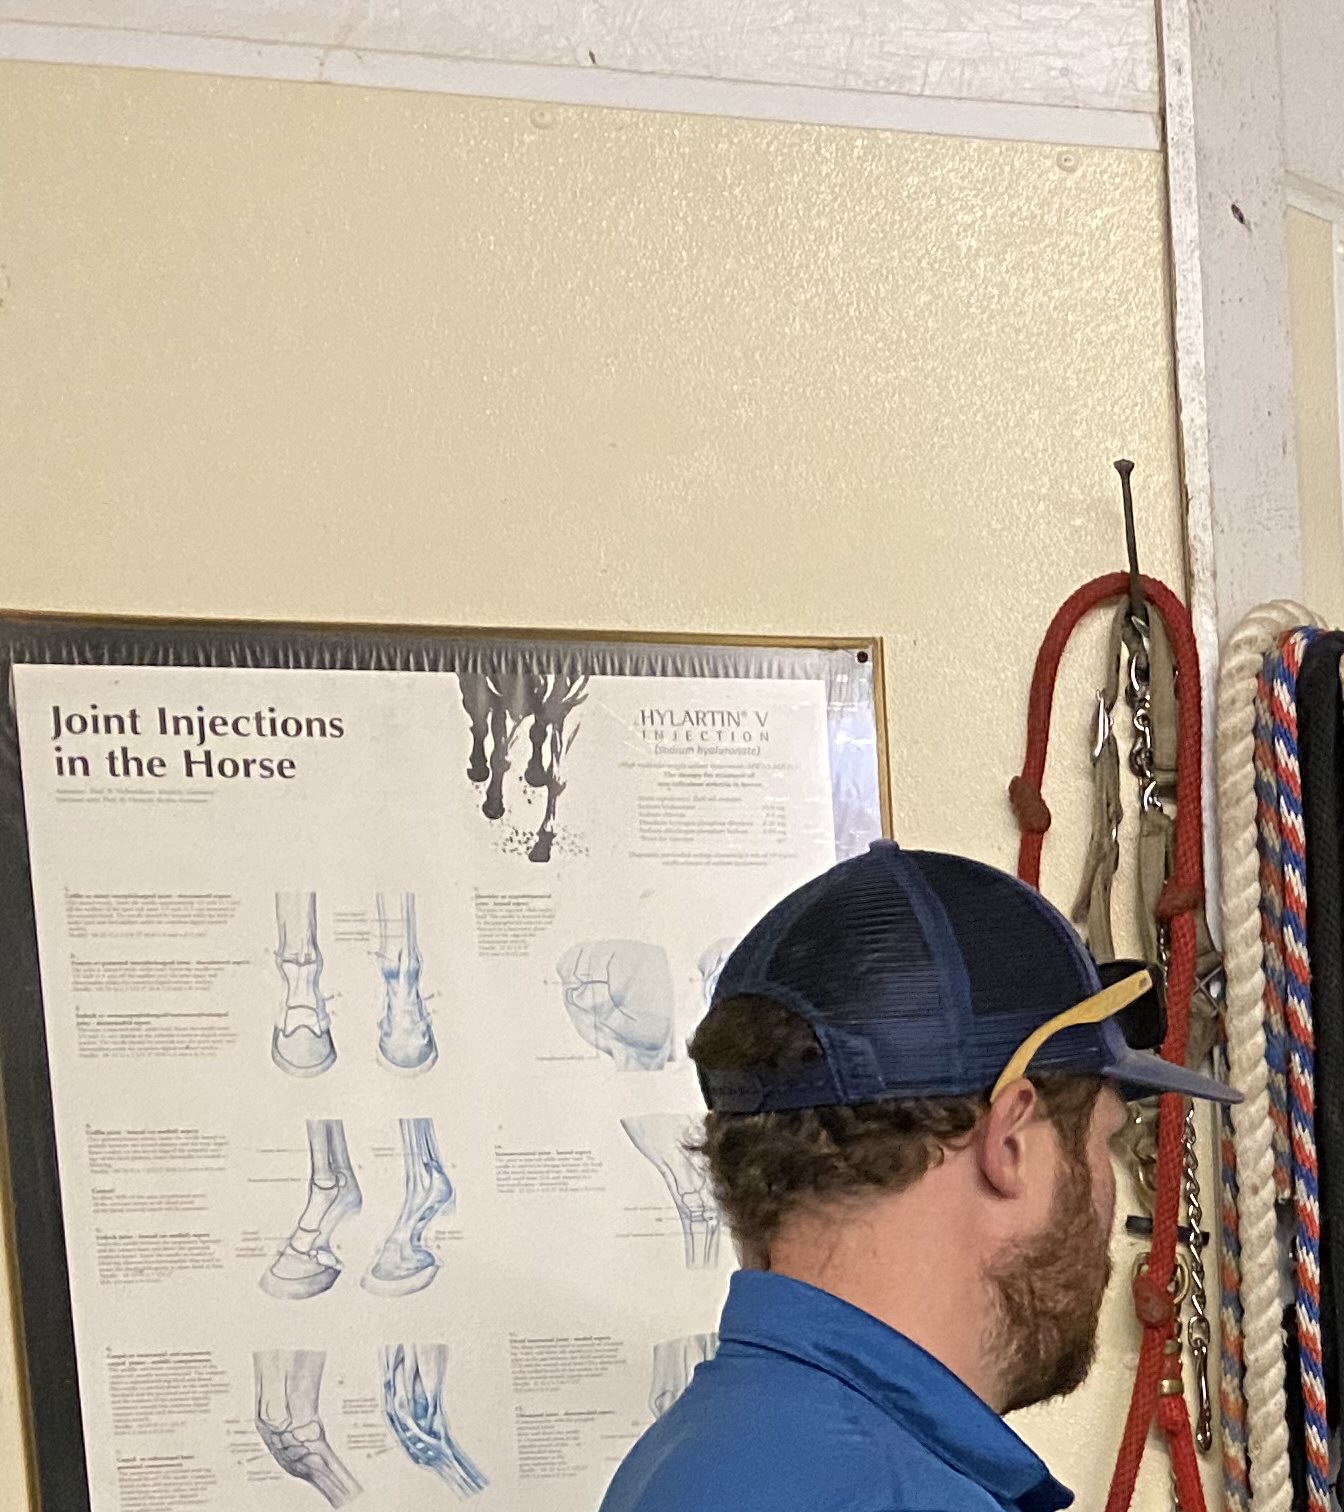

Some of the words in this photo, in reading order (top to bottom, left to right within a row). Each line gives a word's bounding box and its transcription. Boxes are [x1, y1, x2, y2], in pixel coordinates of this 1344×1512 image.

[52, 703, 142, 741] Joint
[157, 705, 345, 746] Injections
[755, 711, 768, 727] V
[642, 730, 769, 742] INJECTION
[55, 746, 90, 776] in
[105, 746, 167, 777] the
[183, 749, 297, 778] Horse
